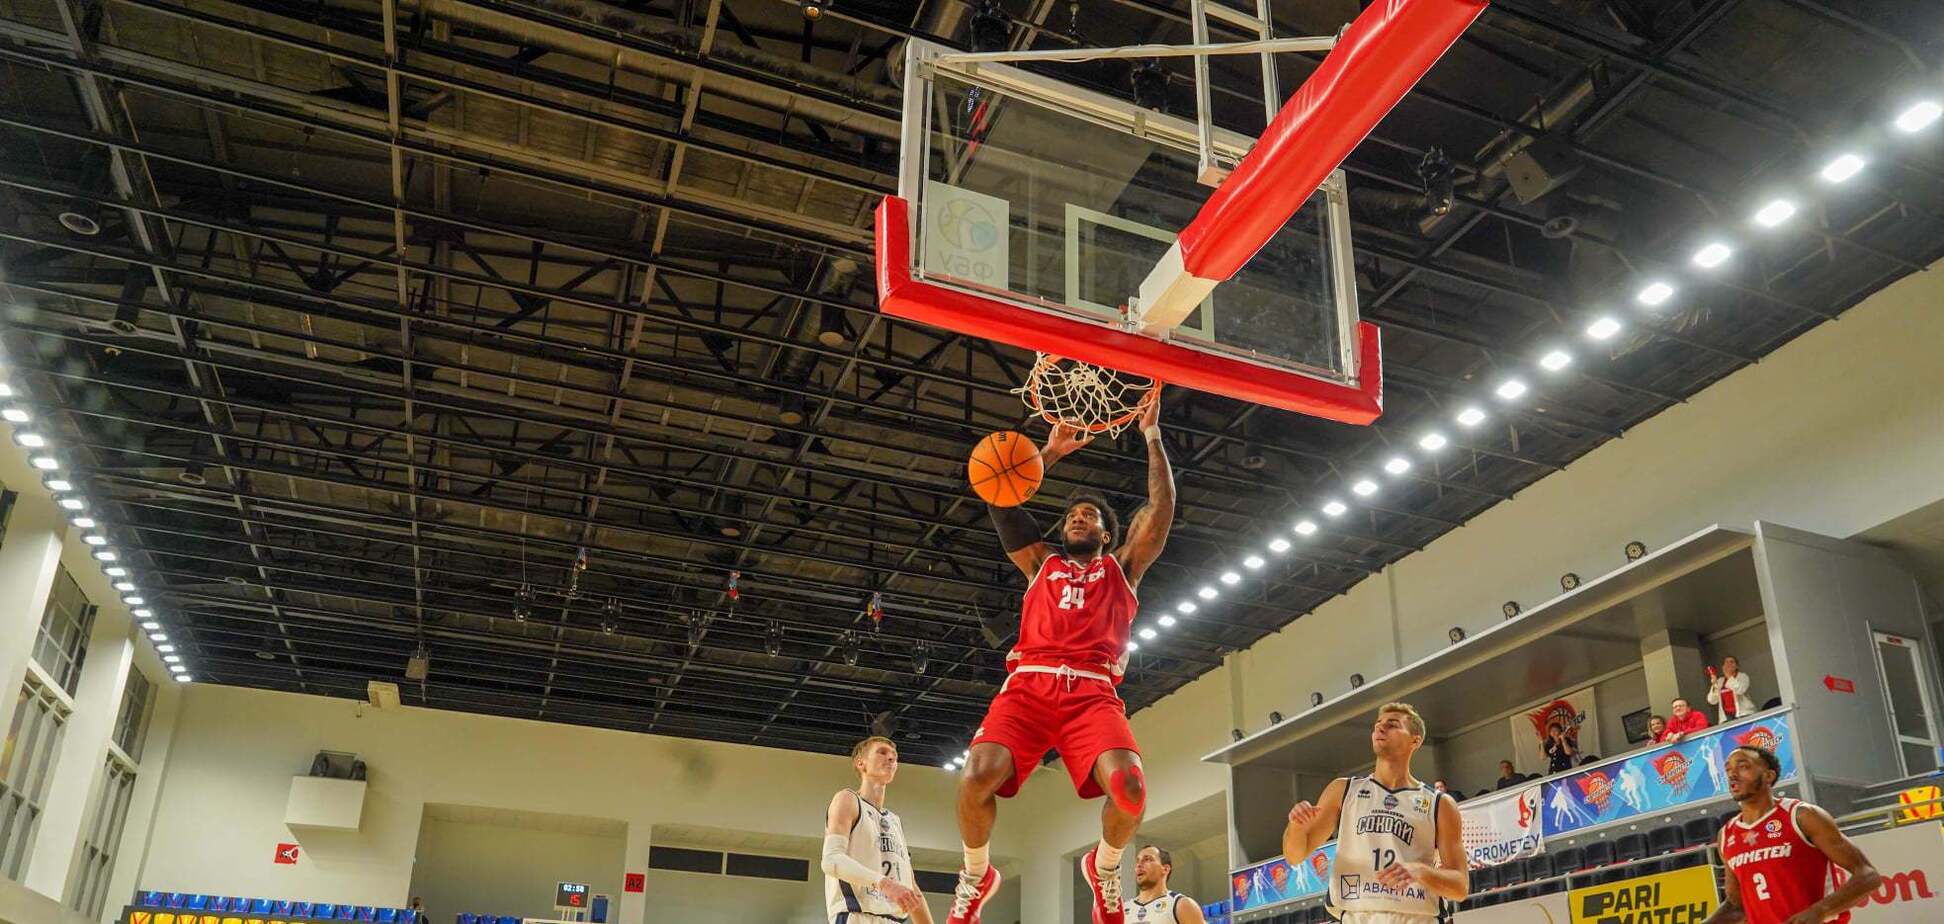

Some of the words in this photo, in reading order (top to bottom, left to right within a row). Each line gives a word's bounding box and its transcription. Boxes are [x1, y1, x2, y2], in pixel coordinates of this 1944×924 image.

[1058, 585, 1086, 610] 24
[1357, 814, 1415, 847] СОКОЛИ
[1372, 848, 1396, 871] 12
[1474, 833, 1540, 861] PROMETEY
[1594, 881, 1661, 917] PARI
[1753, 872, 1771, 900] 2
